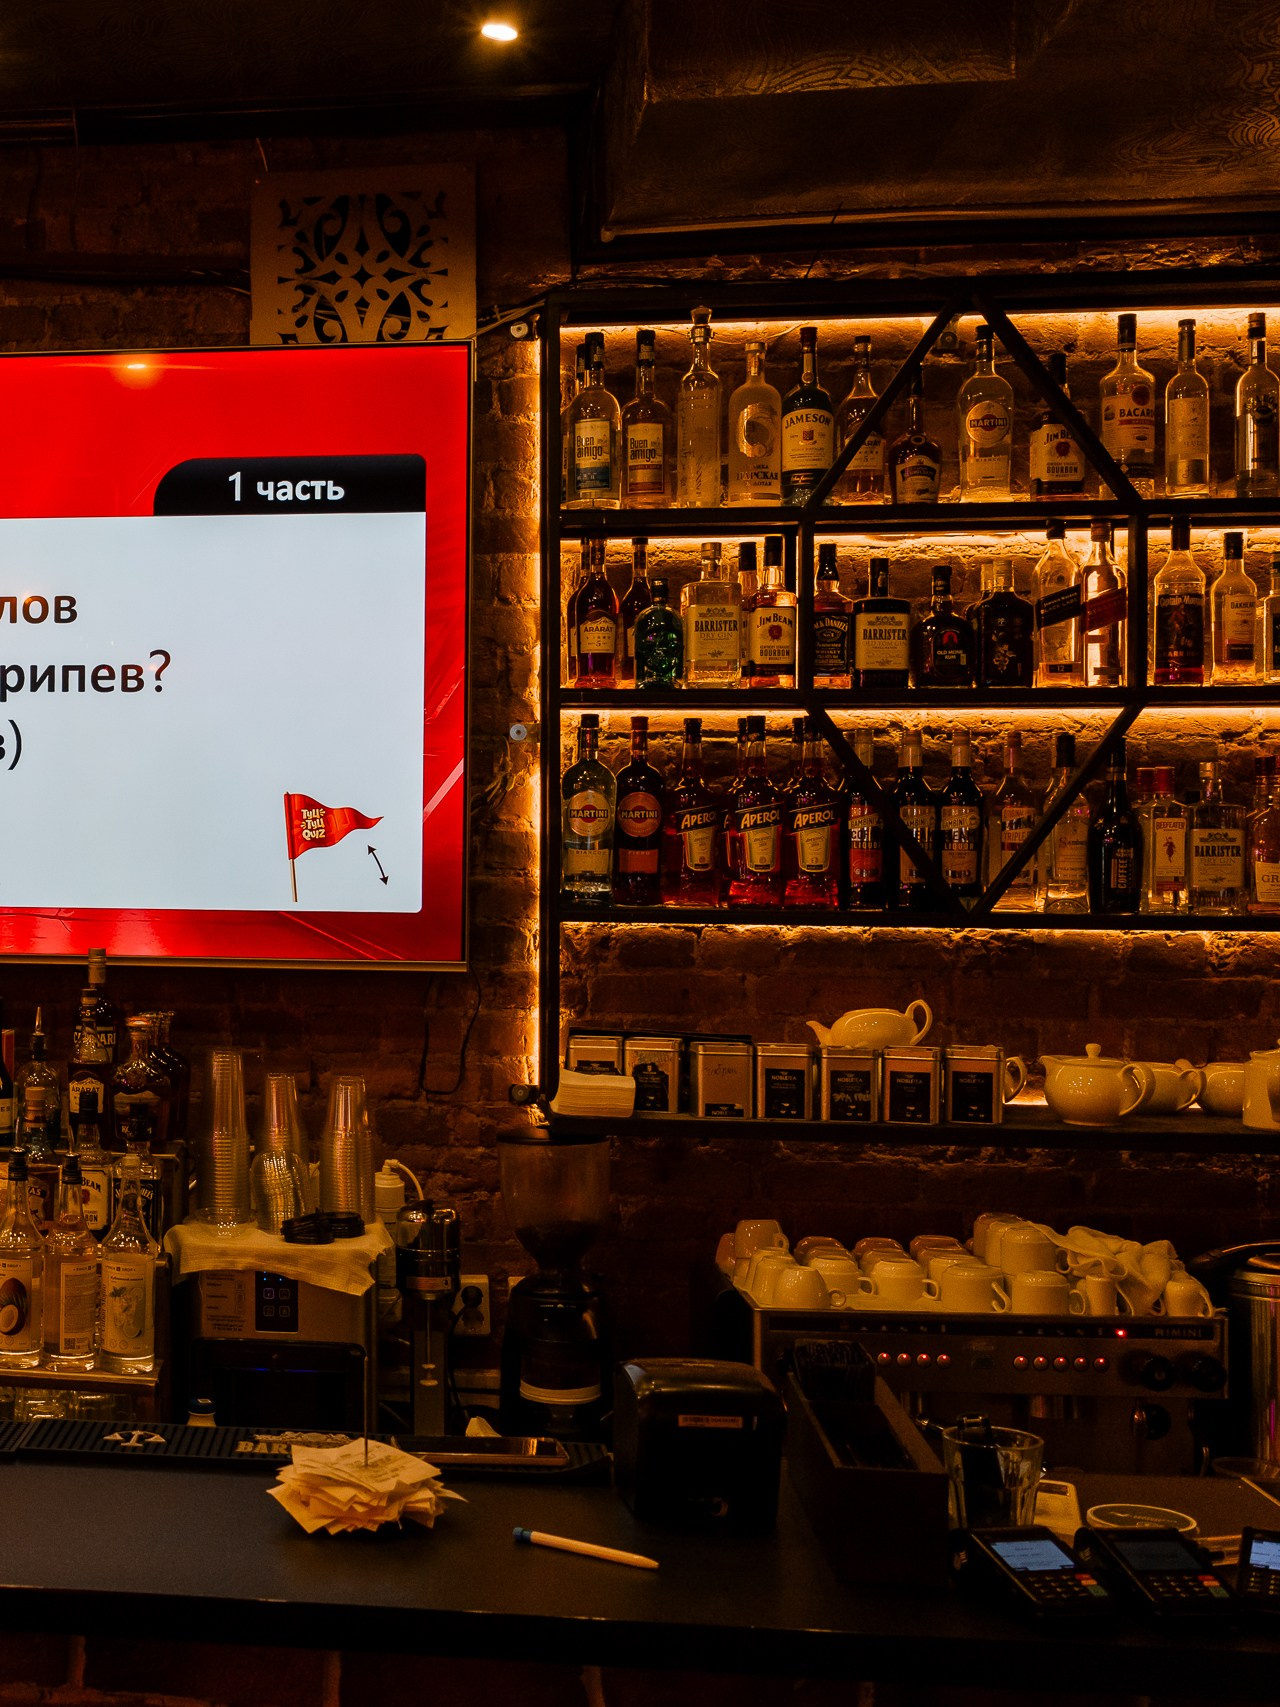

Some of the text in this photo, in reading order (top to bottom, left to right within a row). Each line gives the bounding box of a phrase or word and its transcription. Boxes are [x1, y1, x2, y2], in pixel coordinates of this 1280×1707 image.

[785, 413, 831, 429] JAMESON
[970, 419, 1007, 428] MARTINI
[630, 438, 648, 449] Buen
[630, 448, 657, 462] amigo
[1046, 466, 1078, 474] BOURBON
[228, 472, 345, 502] 1 часть
[694, 620, 738, 632] BARRISTER
[756, 613, 793, 629] JIM BEAM
[583, 625, 614, 633] ARARAT
[863, 628, 907, 640] BARRISTER
[759, 649, 790, 657] BOURBON
[570, 810, 608, 819] MARTINI
[621, 810, 658, 819] MARTINI
[793, 811, 836, 829] APEROL
[1155, 821, 1184, 830] BEEFEATER
[1194, 845, 1241, 857] BARRISTER
[1154, 1327, 1202, 1338] RIMINI
